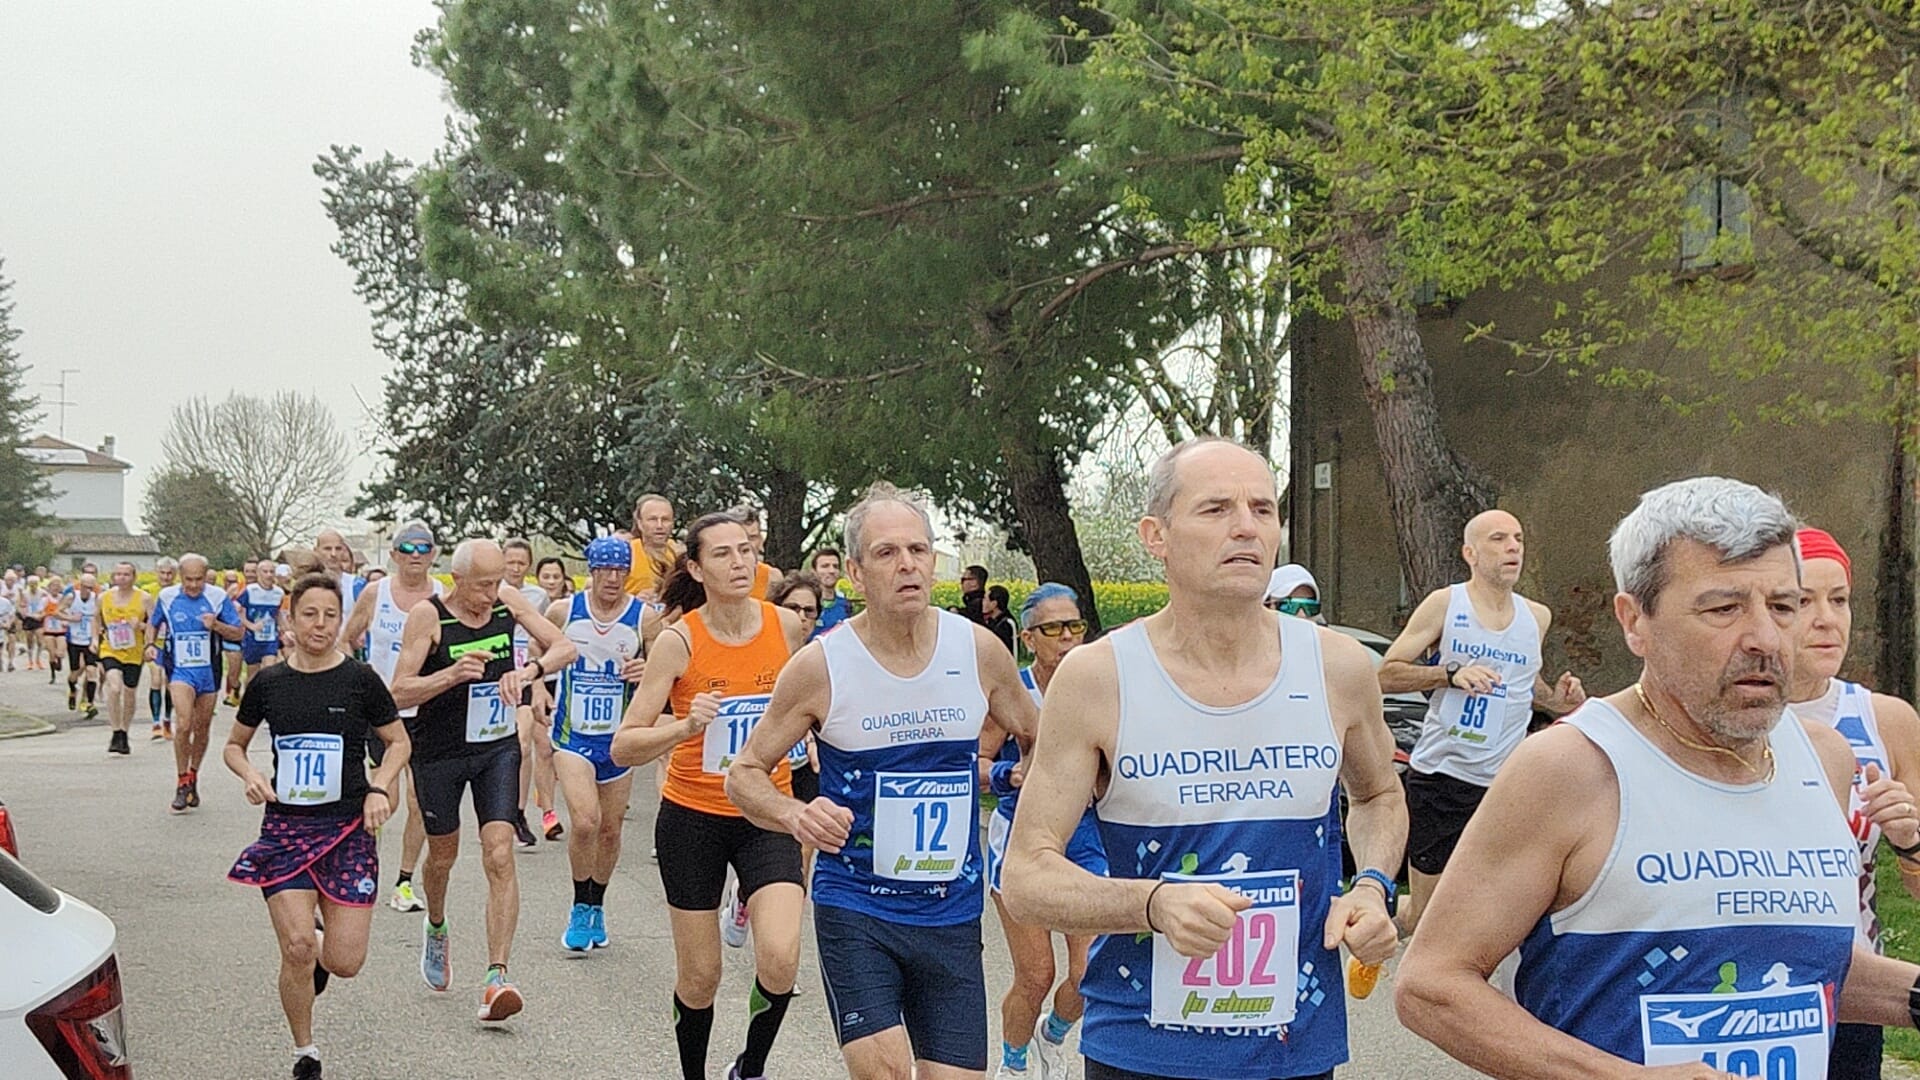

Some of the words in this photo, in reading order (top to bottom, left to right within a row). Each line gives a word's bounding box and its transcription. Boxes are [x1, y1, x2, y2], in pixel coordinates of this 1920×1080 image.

[186, 641, 201, 656] 46
[583, 696, 613, 720] 168
[862, 707, 966, 731] QUADRILATERO
[1459, 695, 1489, 729] 93
[728, 716, 761, 755] 11
[890, 727, 945, 743] FERRARA
[294, 752, 326, 786] 114
[1118, 745, 1338, 780] QUADRILATERO
[1179, 779, 1294, 804] FERRARA
[912, 802, 948, 852] 12
[1636, 848, 1859, 885] QUADRILATERO
[1716, 890, 1838, 916] FERRARA
